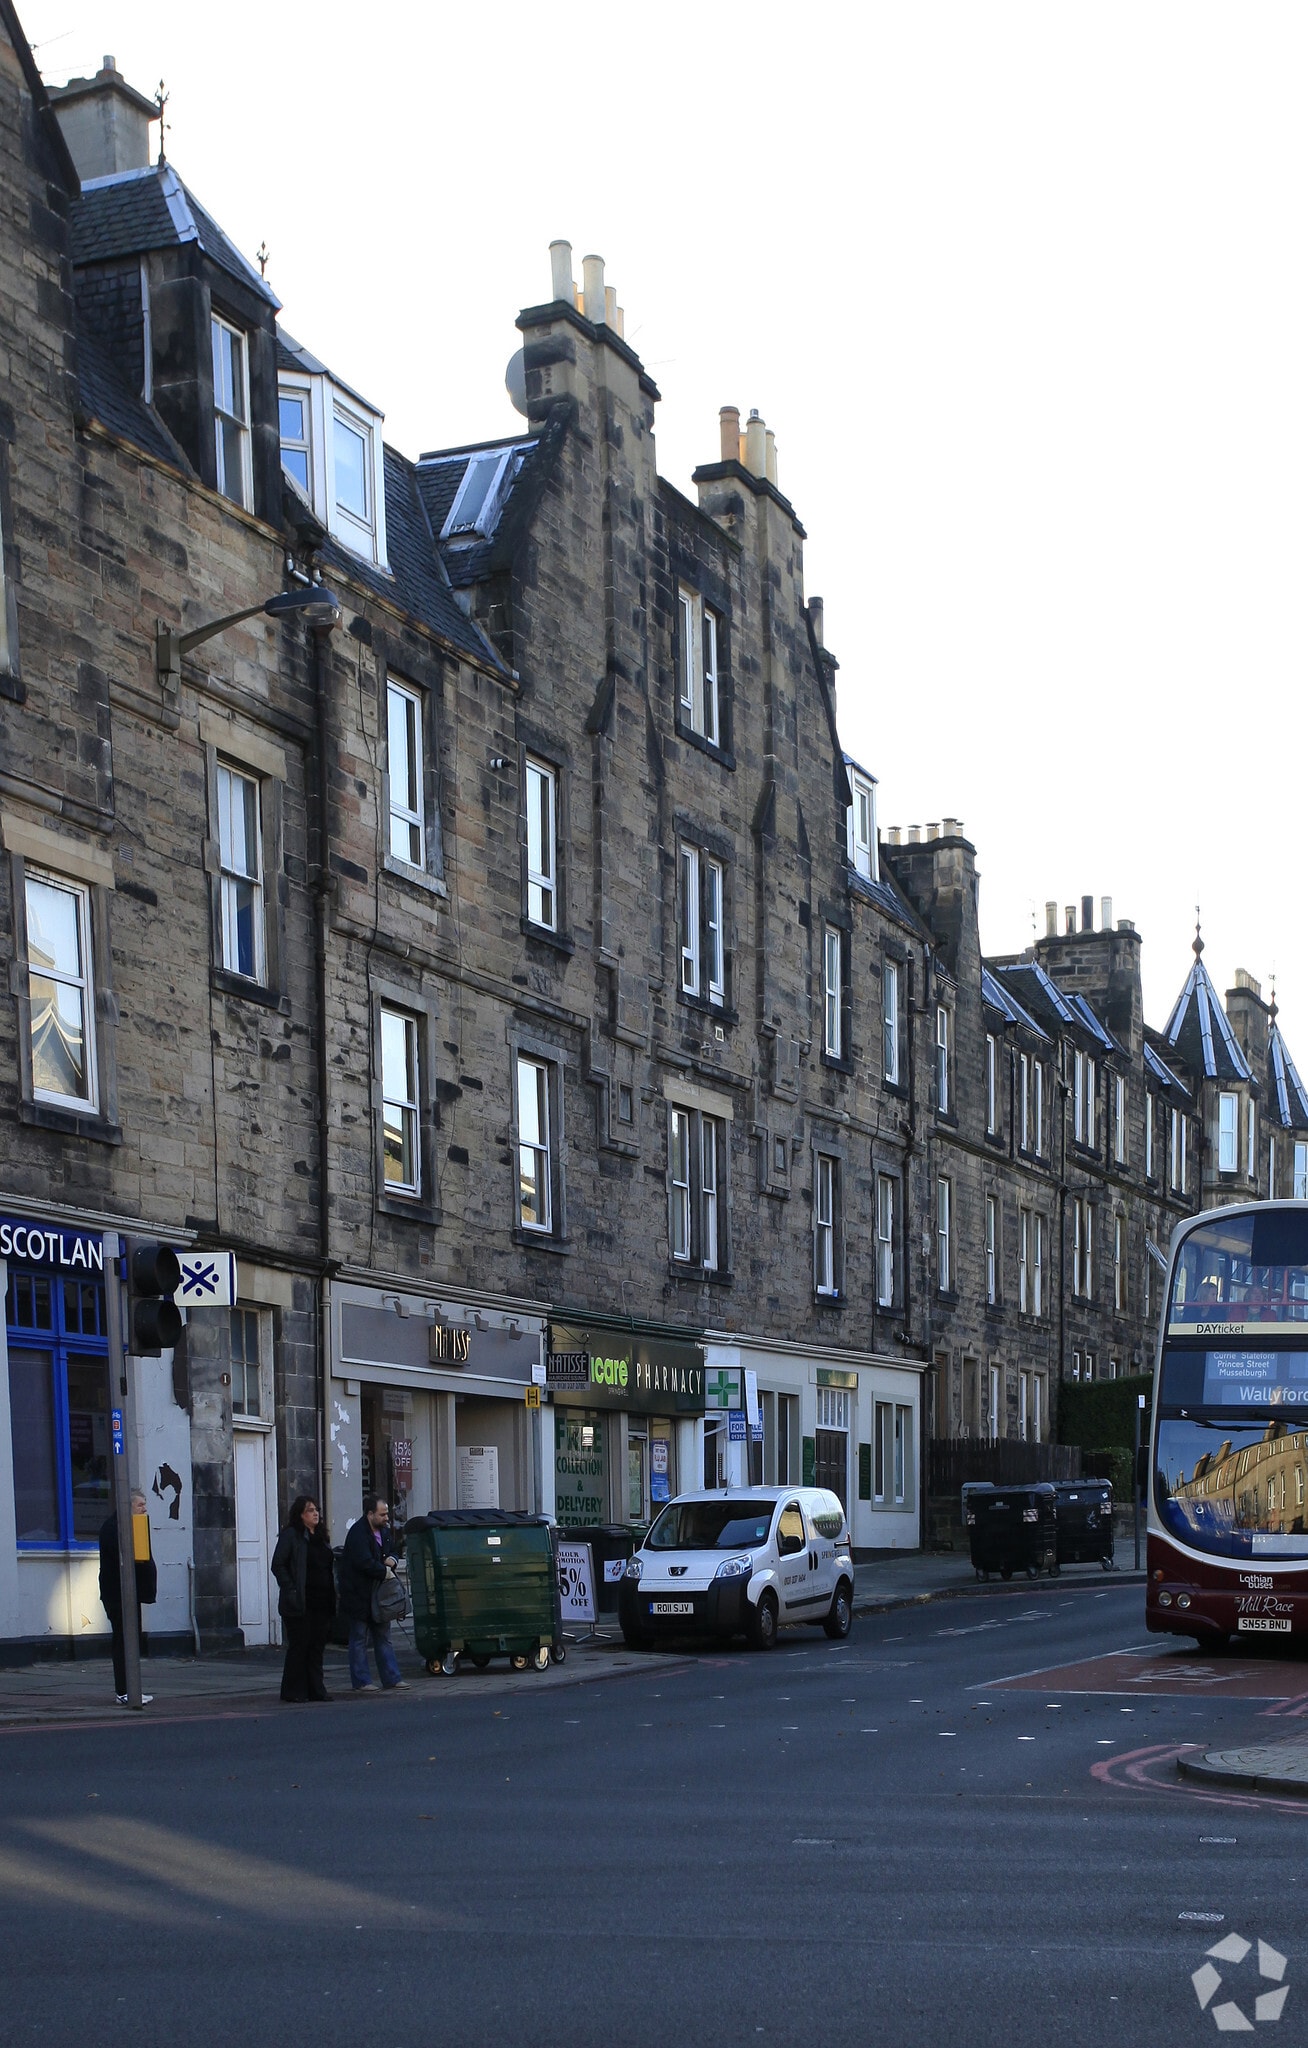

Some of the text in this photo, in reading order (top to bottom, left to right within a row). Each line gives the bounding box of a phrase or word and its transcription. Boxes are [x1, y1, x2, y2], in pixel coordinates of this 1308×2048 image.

[0, 1224, 103, 1271] SCOTLAN
[1196, 1324, 1244, 1334] DAYticket
[435, 1324, 472, 1361] NAISSE
[1213, 1352, 1275, 1360] Currie Slateford
[548, 1354, 587, 1373] NATISSE
[1217, 1360, 1270, 1368] Princes Street
[636, 1362, 701, 1395] PHARMACY
[1219, 1369, 1267, 1377] Musselburgh
[527, 1389, 538, 1406] H
[731, 1423, 745, 1431] FOR
[556, 1417, 602, 1453] FRE
[394, 1441, 412, 1456] 15%
[394, 1457, 411, 1467] OFF
[556, 1456, 603, 1476] COLLECTION
[577, 1480, 584, 1492] &
[557, 1495, 603, 1513] DELIVERY
[559, 1566, 587, 1597] 5%
[1239, 1574, 1273, 1583] Lothian
[1248, 1581, 1274, 1590] buses
[570, 1598, 589, 1606] OFF
[657, 1603, 689, 1613] RO11 SJV
[1238, 1596, 1294, 1617] Mill Race
[1242, 1619, 1288, 1630] SN55 BNU
